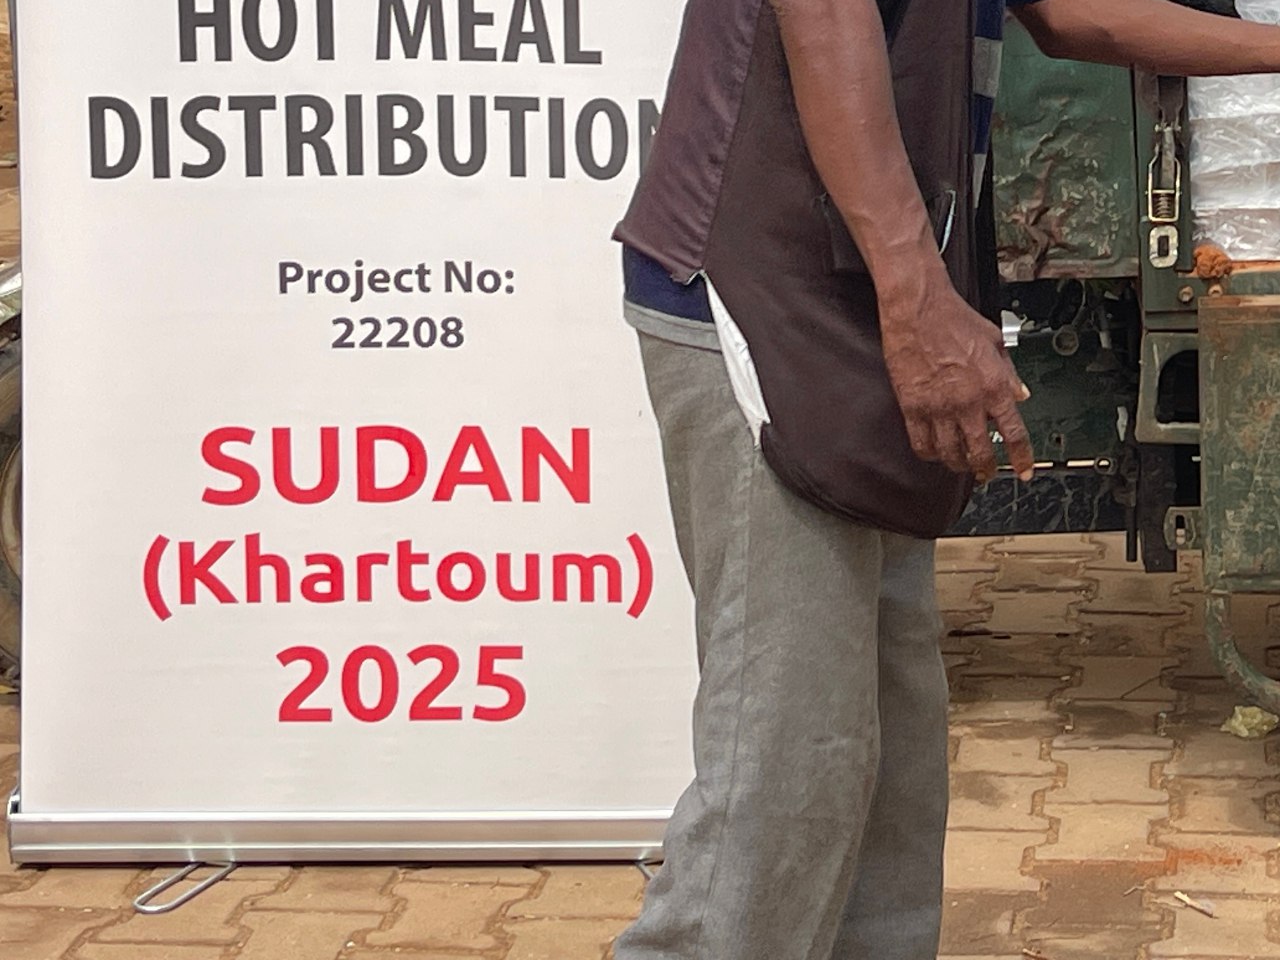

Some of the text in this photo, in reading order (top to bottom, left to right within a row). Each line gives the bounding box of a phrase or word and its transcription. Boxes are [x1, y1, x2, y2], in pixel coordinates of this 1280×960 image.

[279, 260, 515, 302] Project No:
[332, 317, 464, 349] 22208
[201, 425, 590, 505] SUDAN
[144, 533, 653, 621] (Khartoum)
[276, 645, 526, 722] 2025
